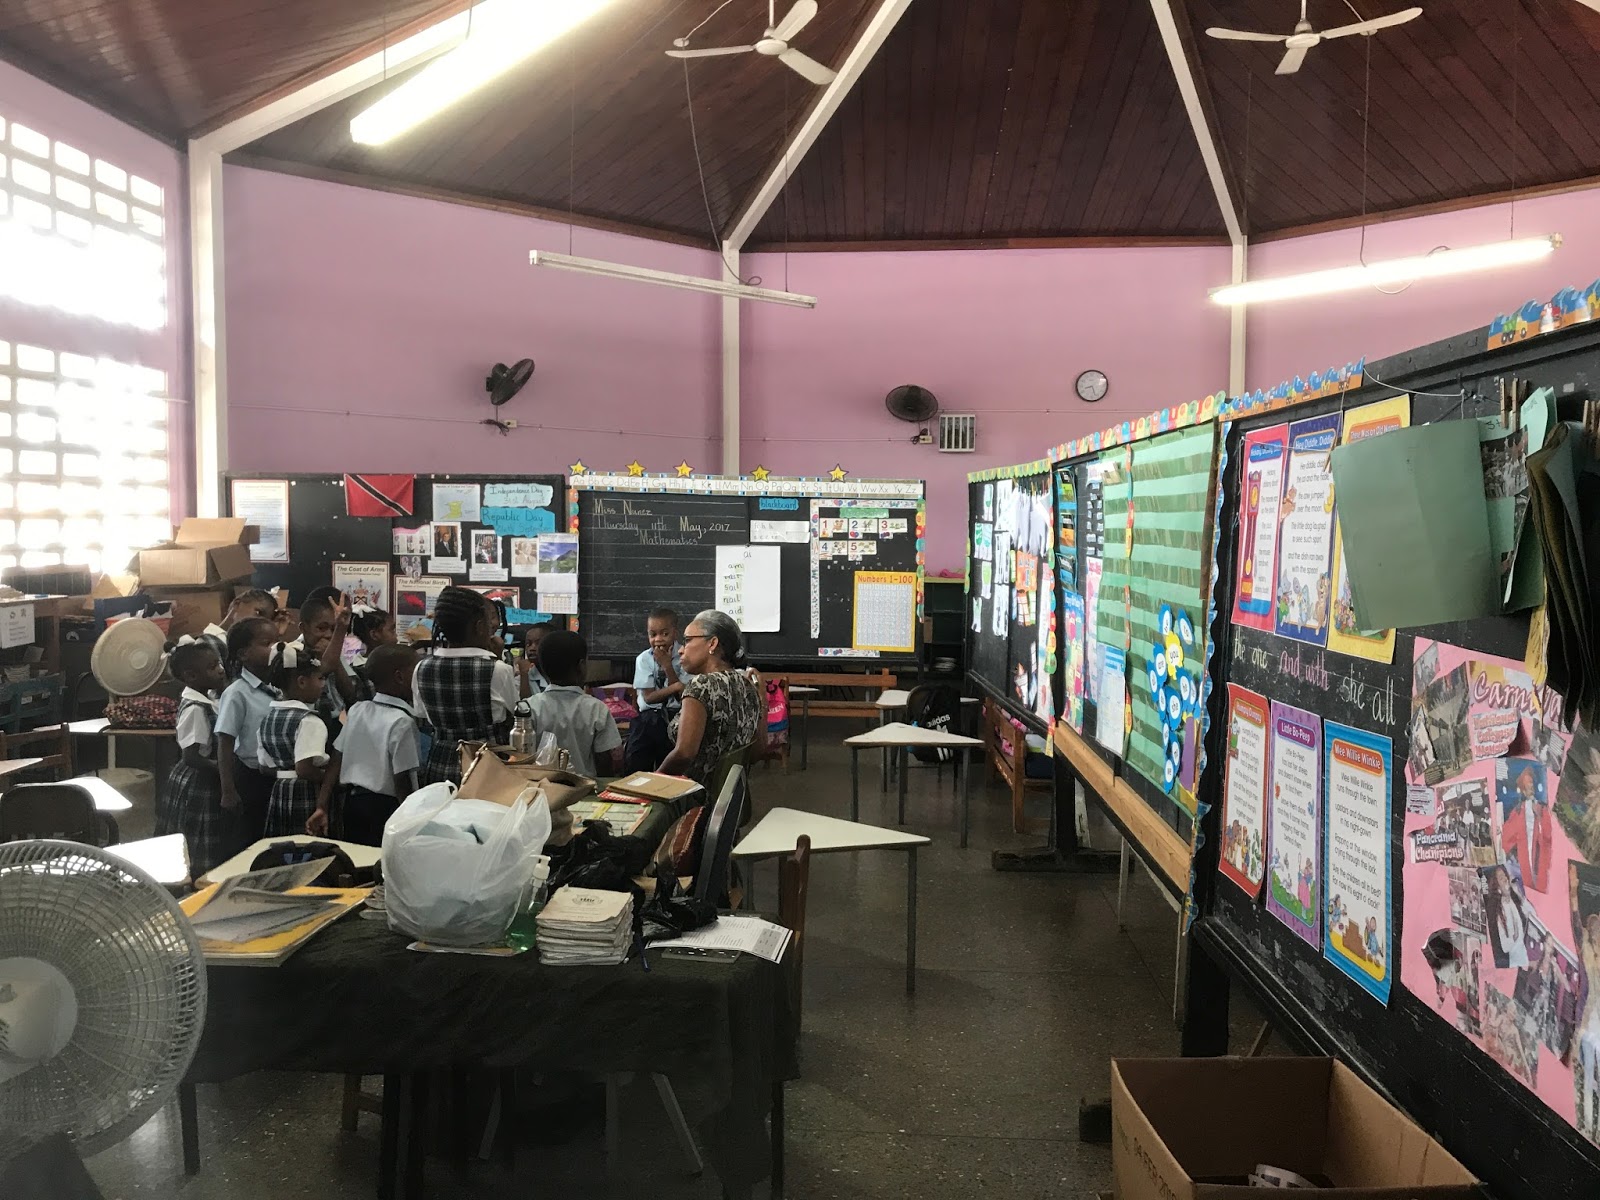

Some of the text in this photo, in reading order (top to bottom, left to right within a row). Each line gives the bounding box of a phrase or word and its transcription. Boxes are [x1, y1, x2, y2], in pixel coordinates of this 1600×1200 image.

[531, 485, 543, 496] Day
[595, 499, 616, 514] Miss
[761, 499, 797, 509] blackboard
[482, 508, 543, 527] Republic Day
[823, 520, 828, 528] 1
[882, 520, 888, 529] 3
[680, 516, 707, 539] May,
[709, 523, 730, 531] 2017
[640, 530, 698, 545] Mathematics
[851, 542, 857, 551] 5
[889, 575, 913, 584] 1-100
[1234, 631, 1246, 662] the
[1169, 651, 1179, 663] you
[1252, 646, 1268, 669] one
[1280, 643, 1300, 680] and
[1305, 651, 1331, 691] with
[1341, 663, 1365, 710] she
[1372, 676, 1396, 726] all
[1281, 722, 1292, 734] Little
[1334, 744, 1381, 769] Wee Willie Winkie
[1415, 846, 1464, 862] Champions
